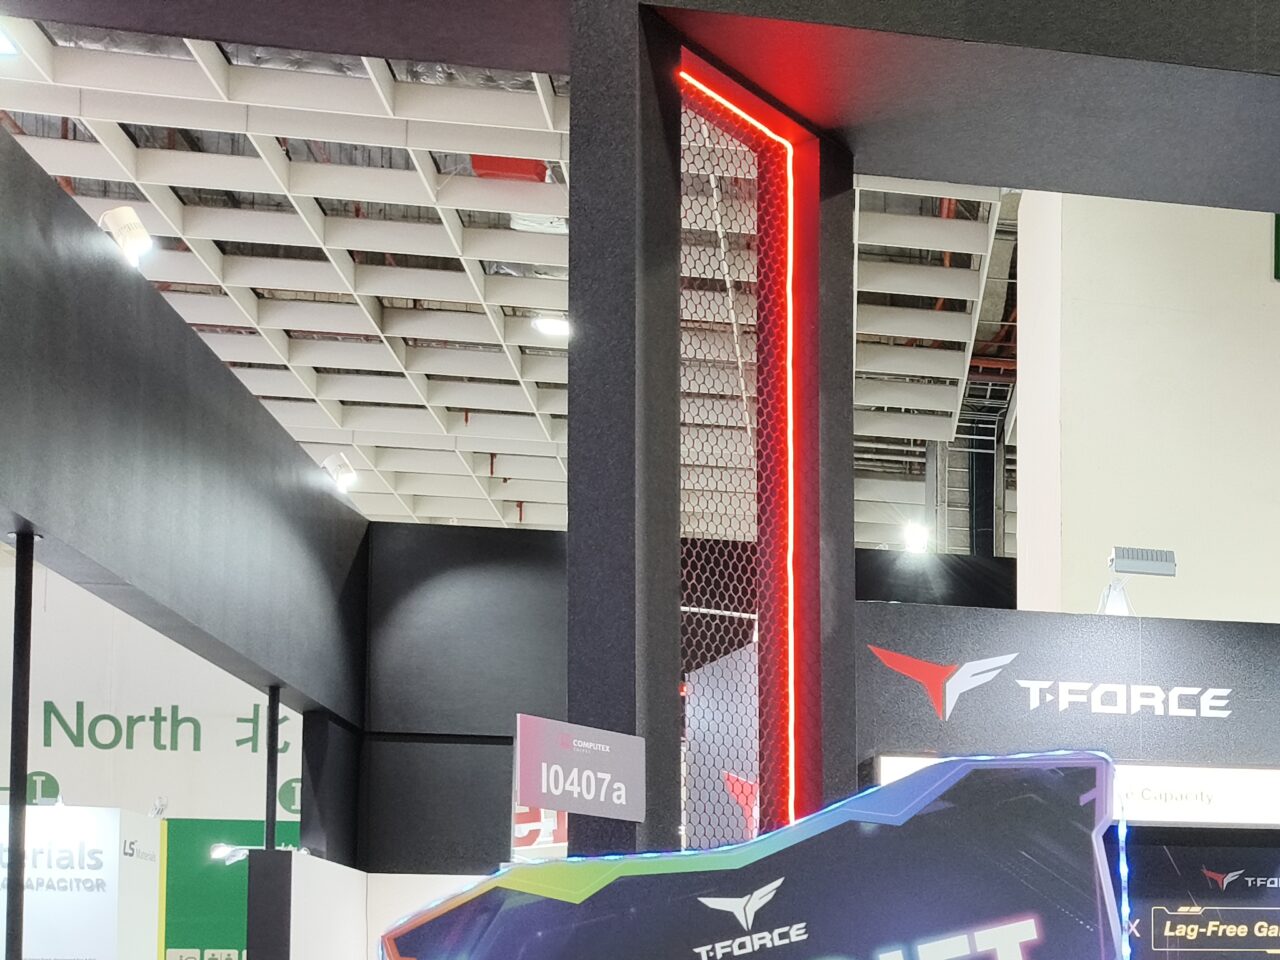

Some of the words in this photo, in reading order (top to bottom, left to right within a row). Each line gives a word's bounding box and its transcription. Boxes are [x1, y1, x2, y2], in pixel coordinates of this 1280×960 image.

[43, 700, 202, 751] North
[572, 739, 611, 753] COMPUTEX
[123, 839, 136, 858] LS
[1164, 920, 1249, 940] Lag-Free
